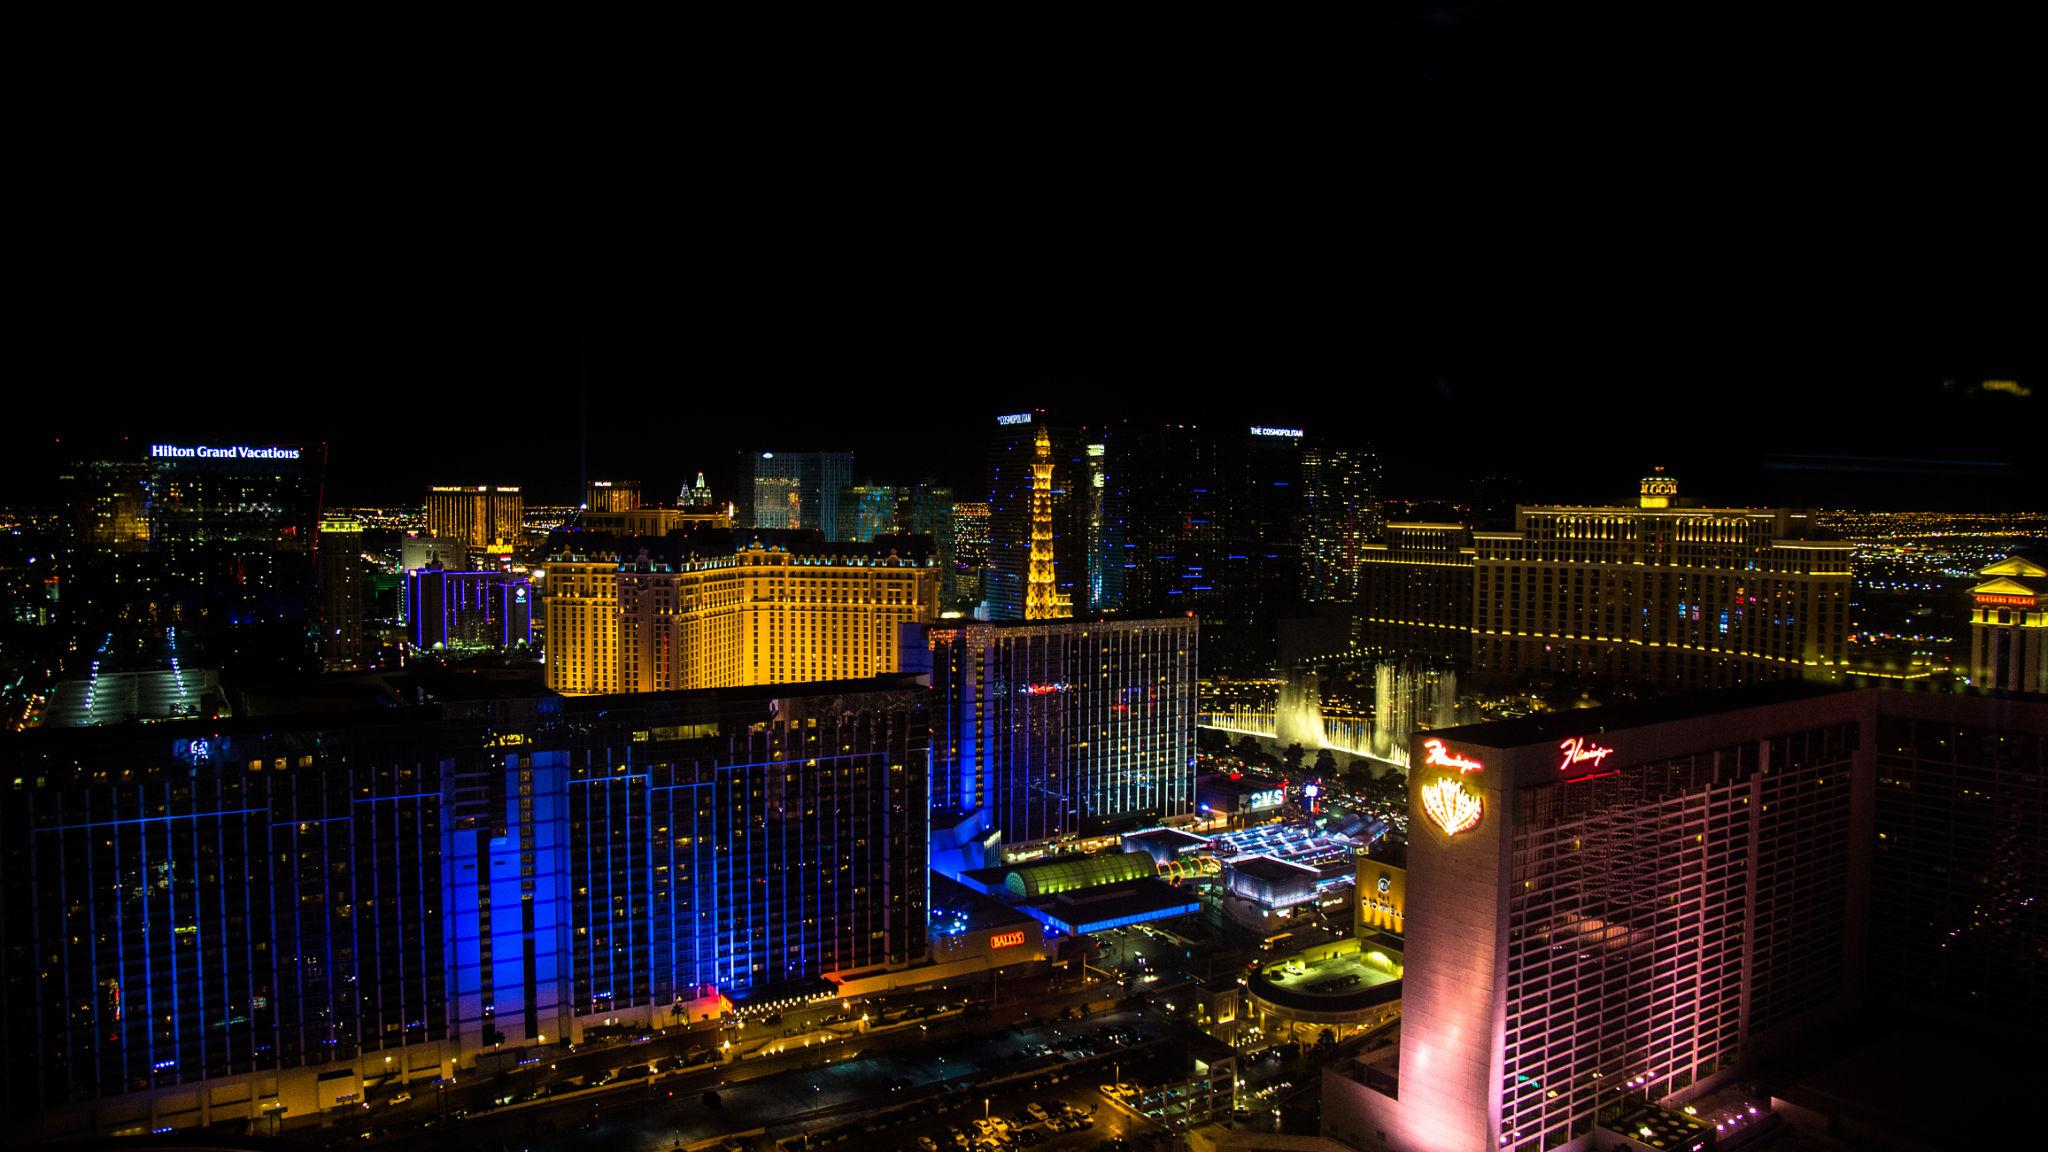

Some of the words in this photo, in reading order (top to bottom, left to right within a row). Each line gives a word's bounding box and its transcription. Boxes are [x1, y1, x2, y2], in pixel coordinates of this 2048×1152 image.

[1000, 414, 1031, 425] COSMOPOLITAN
[1251, 427, 1262, 435] THE
[1263, 428, 1303, 437] COSMOPOLITAN
[152, 445, 195, 457] Hilton
[197, 446, 237, 458] Grand
[238, 447, 299, 459] Vacations
[487, 545, 513, 554] MGM
[1976, 595, 2006, 603] CAESARS
[2008, 598, 2035, 606] PALACE
[1560, 737, 1613, 769] Flamingo
[1251, 789, 1283, 808] CVS
